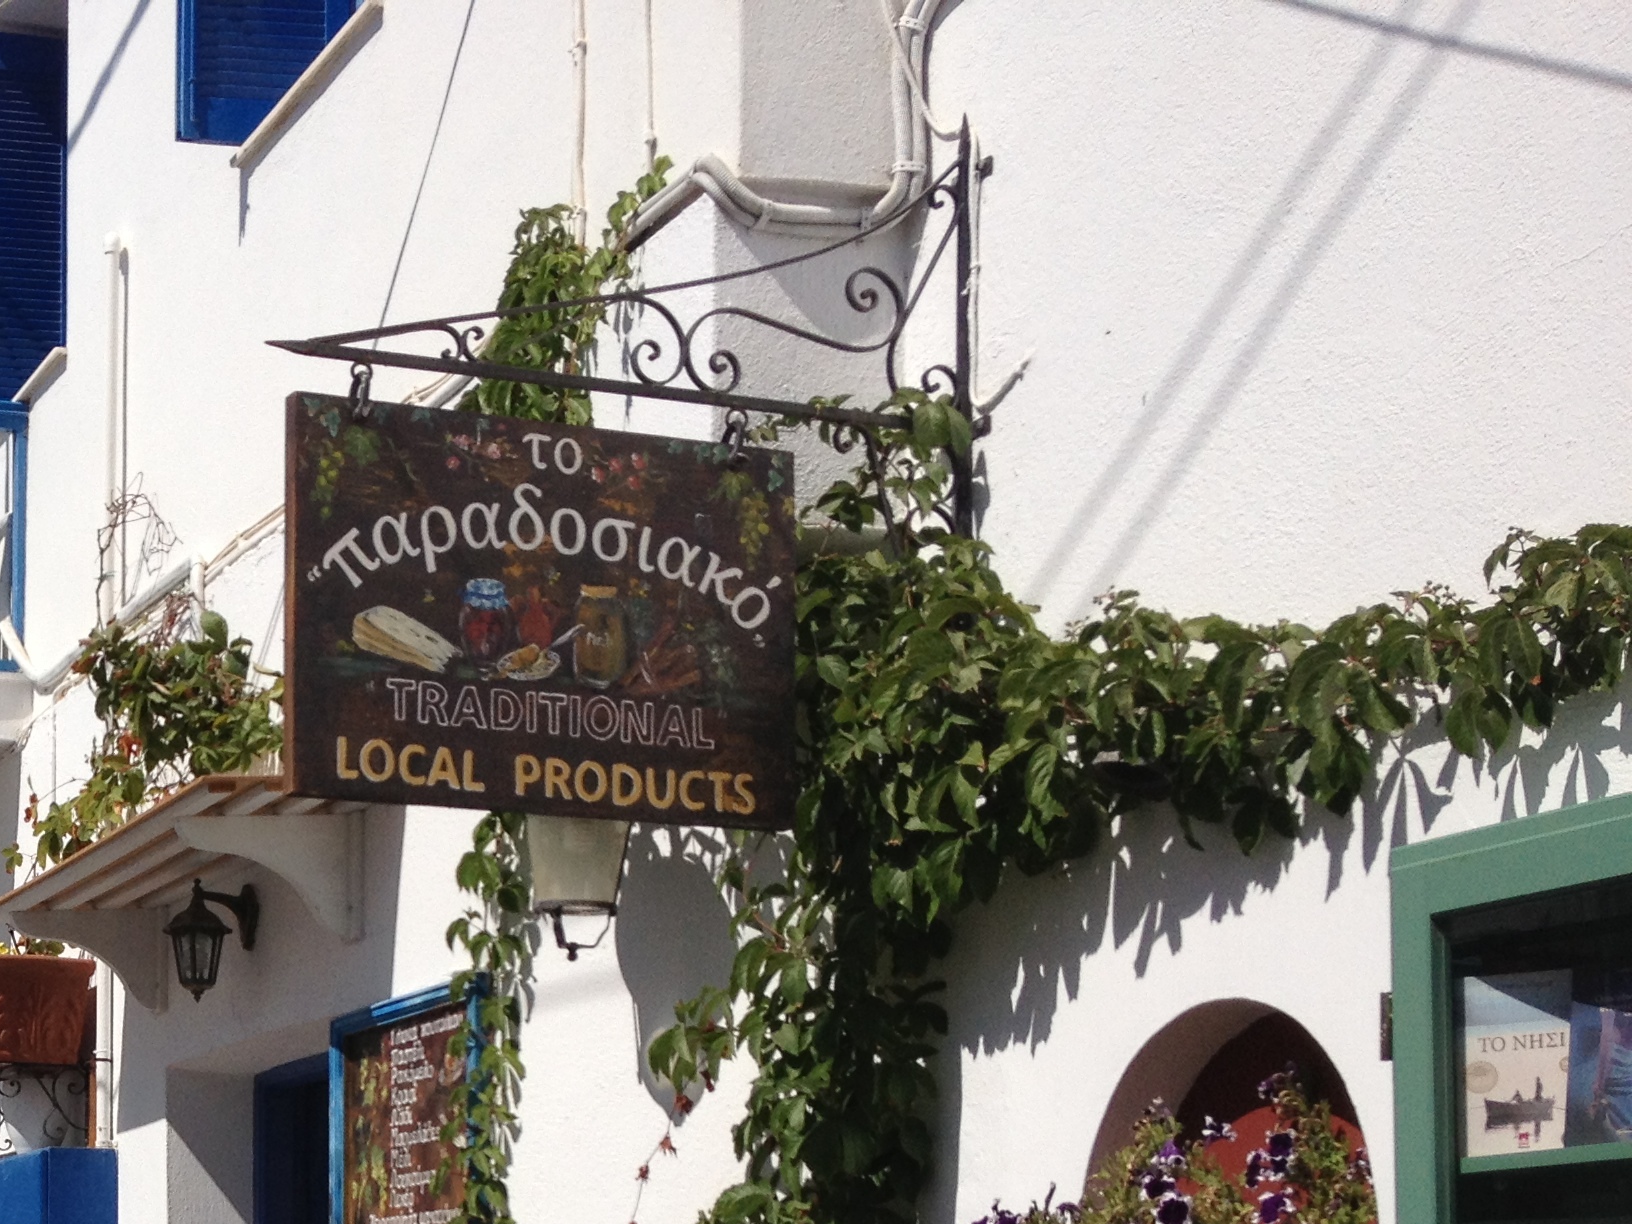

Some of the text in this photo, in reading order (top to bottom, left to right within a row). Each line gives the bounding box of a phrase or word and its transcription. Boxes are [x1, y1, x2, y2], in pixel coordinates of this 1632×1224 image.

[335, 735, 755, 813] LOCAL PRODUCTS
[1479, 1032, 1566, 1052] ΤΟ ΝΗΣΙ
